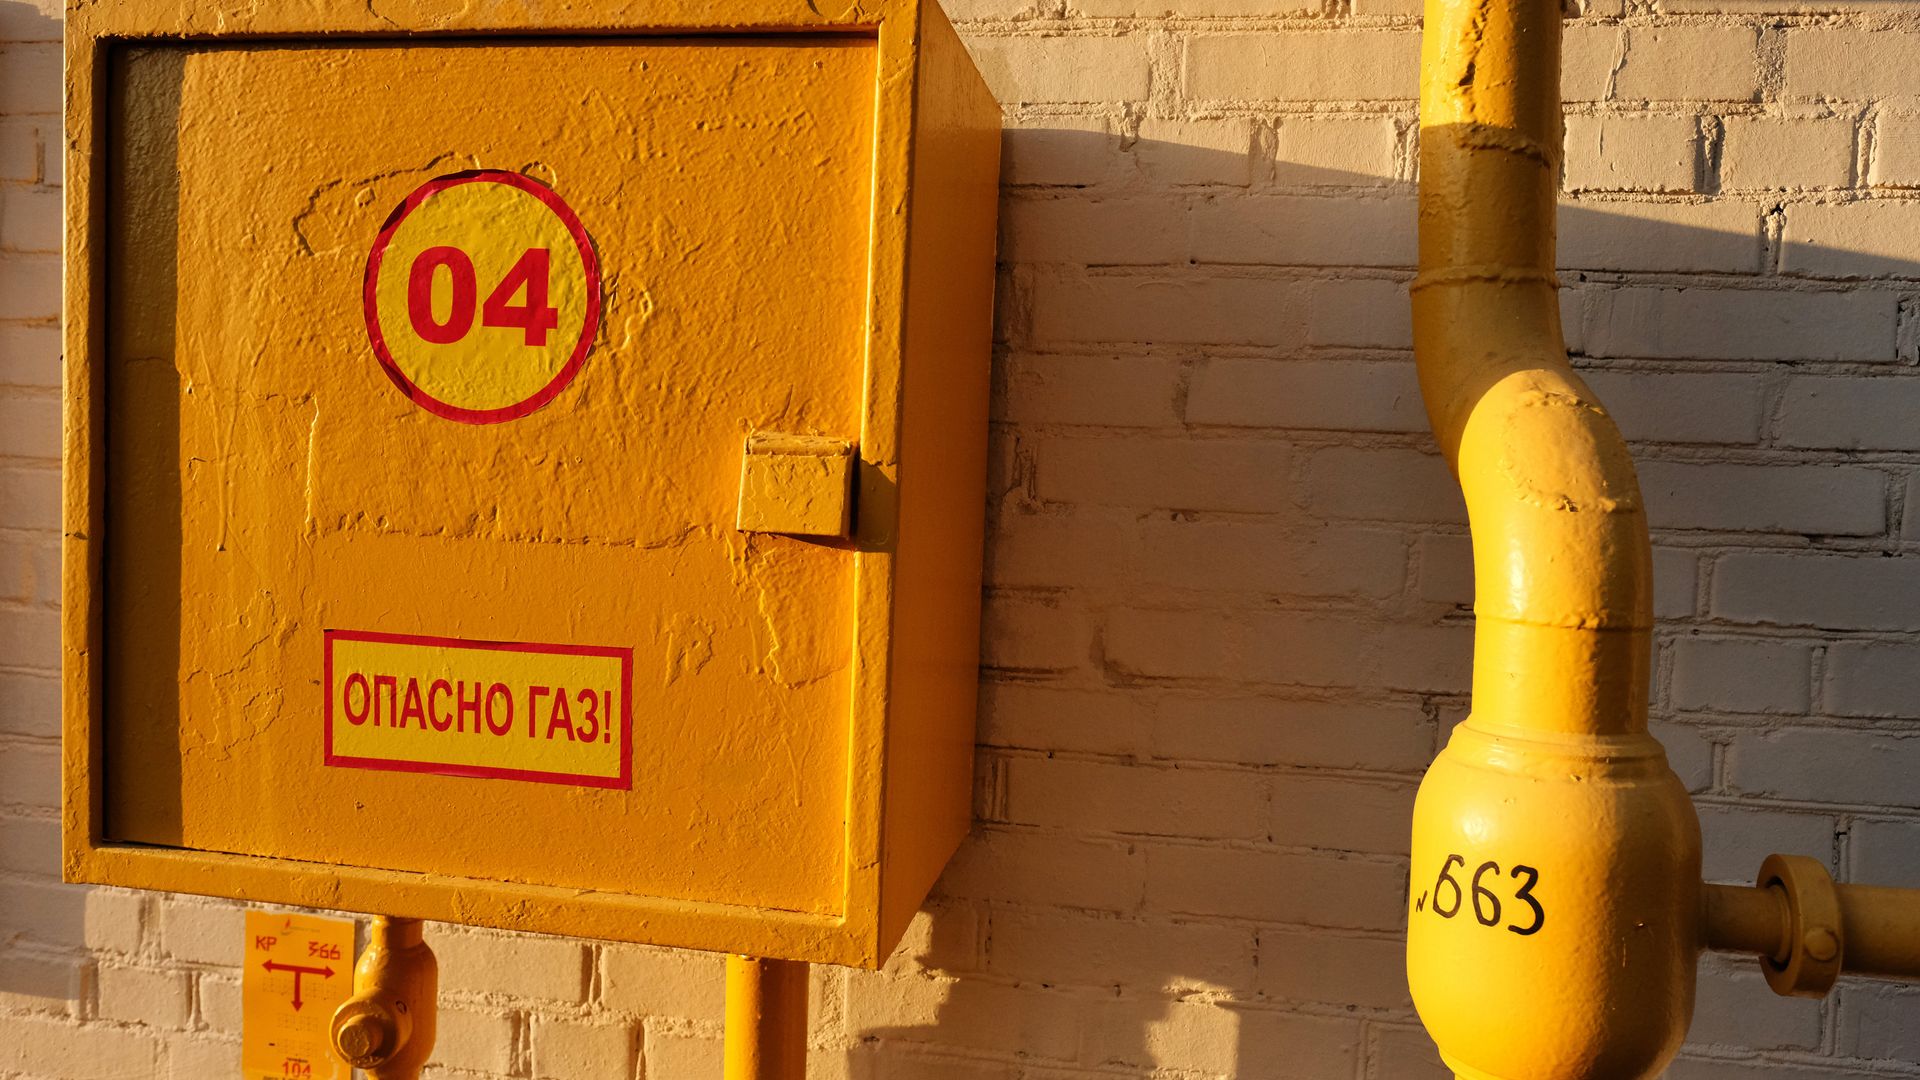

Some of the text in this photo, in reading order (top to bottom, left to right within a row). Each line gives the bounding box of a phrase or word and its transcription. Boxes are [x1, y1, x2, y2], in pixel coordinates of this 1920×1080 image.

[407, 245, 558, 347] 04
[343, 672, 612, 745] ОПАСНО ГАЗ!
[282, 1061, 312, 1079] 104
